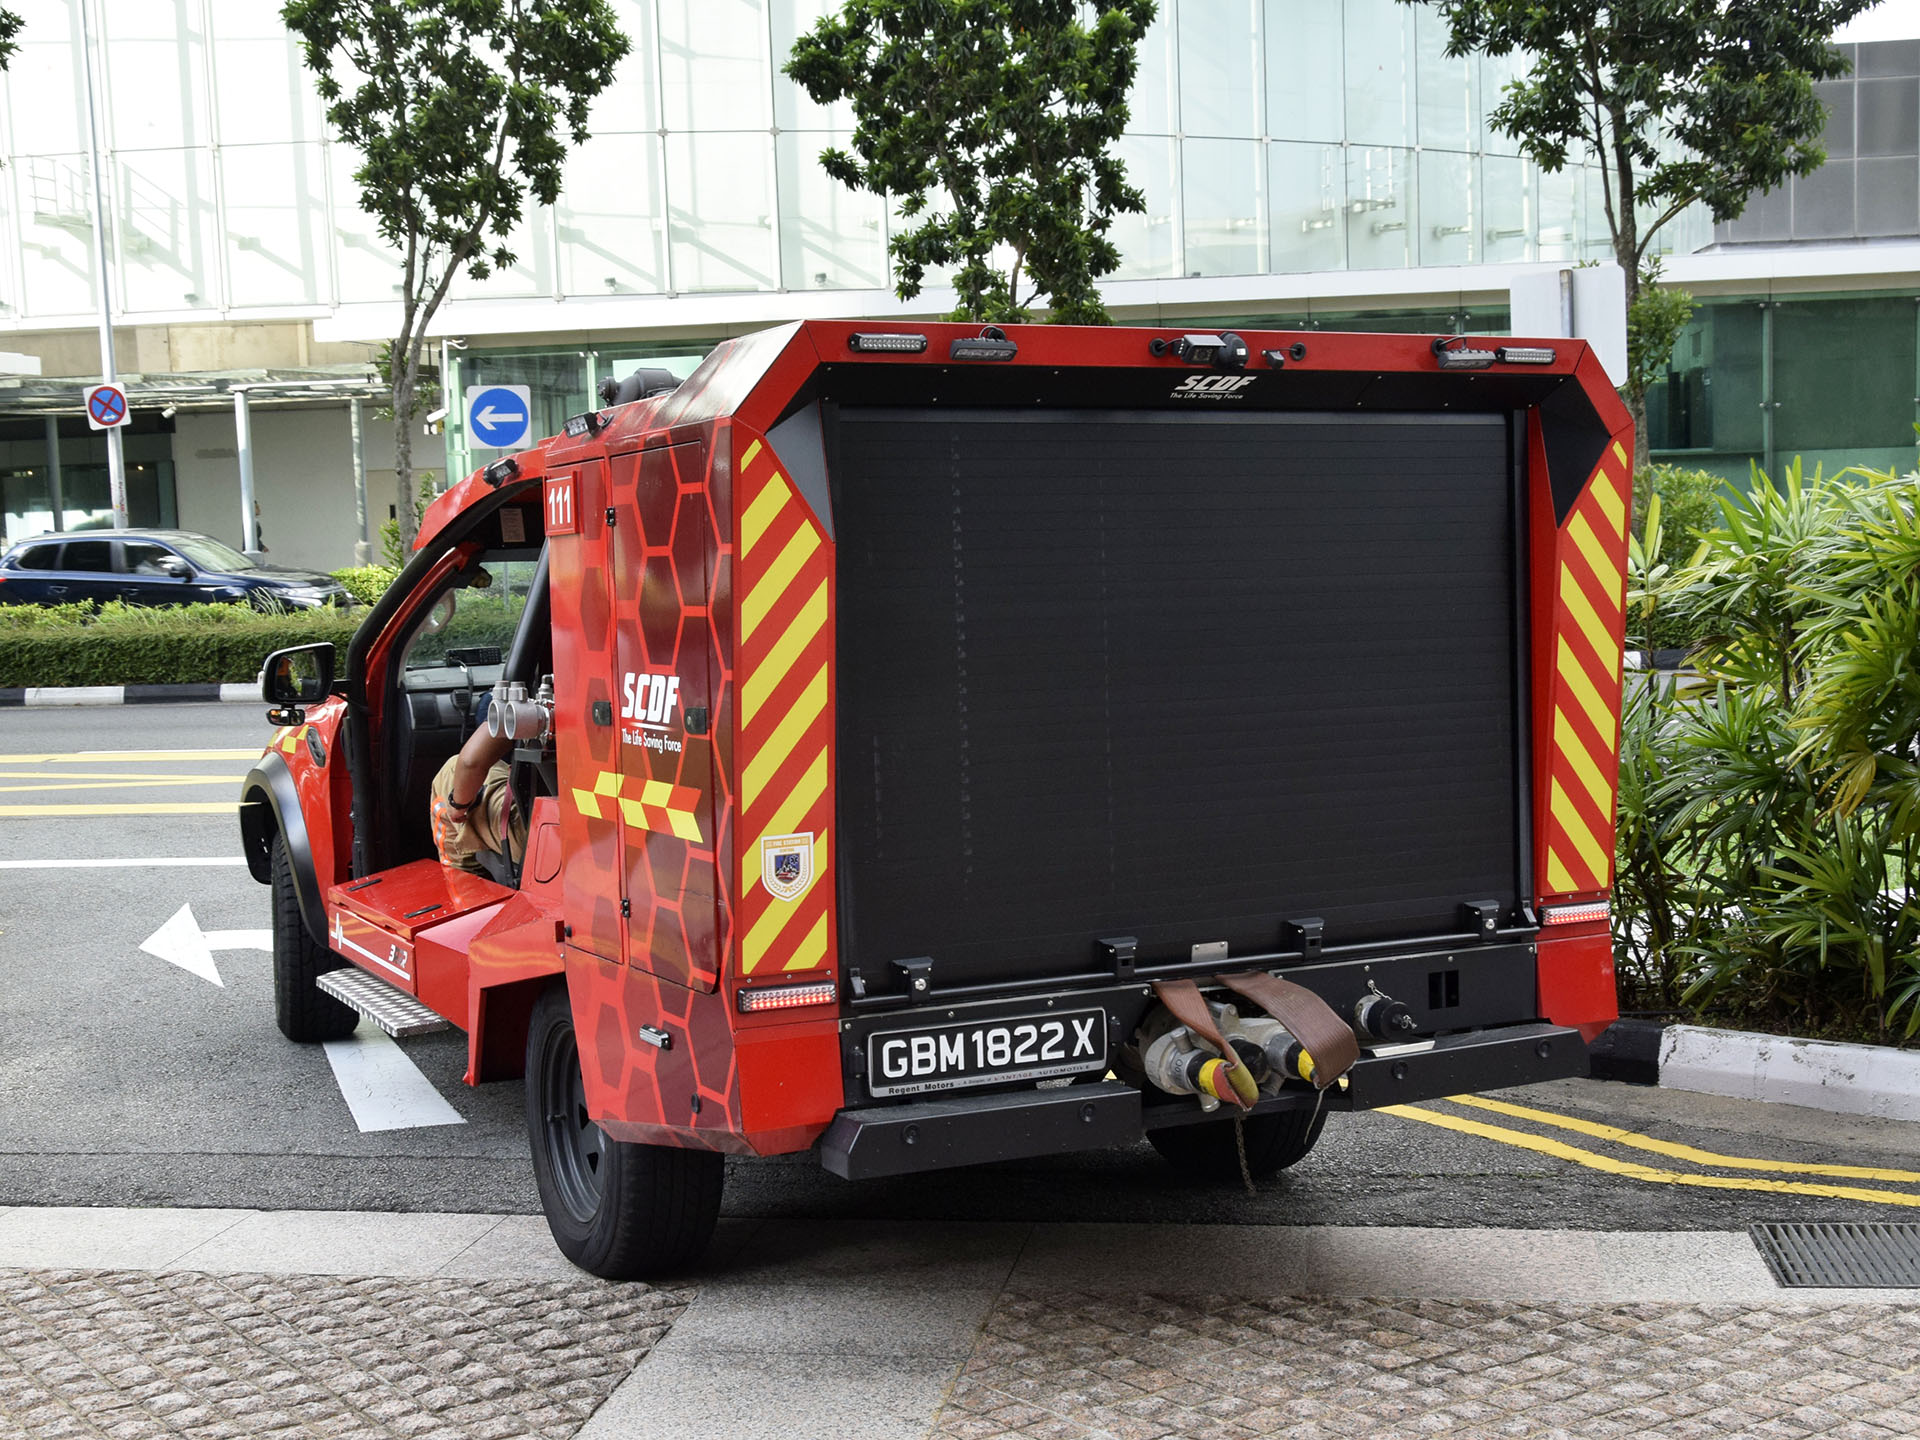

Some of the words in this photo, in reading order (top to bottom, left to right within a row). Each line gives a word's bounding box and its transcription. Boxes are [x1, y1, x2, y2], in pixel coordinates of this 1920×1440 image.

[1174, 375, 1258, 391] SCDF
[1199, 392, 1223, 401] Saving
[549, 485, 571, 525] 111
[621, 672, 680, 724] SCDF
[622, 727, 632, 745] The
[633, 729, 643, 747] Life
[643, 731, 664, 754] Saving
[664, 735, 682, 753] Force
[888, 1085, 920, 1095] Regent
[924, 1082, 954, 1091] Motors
